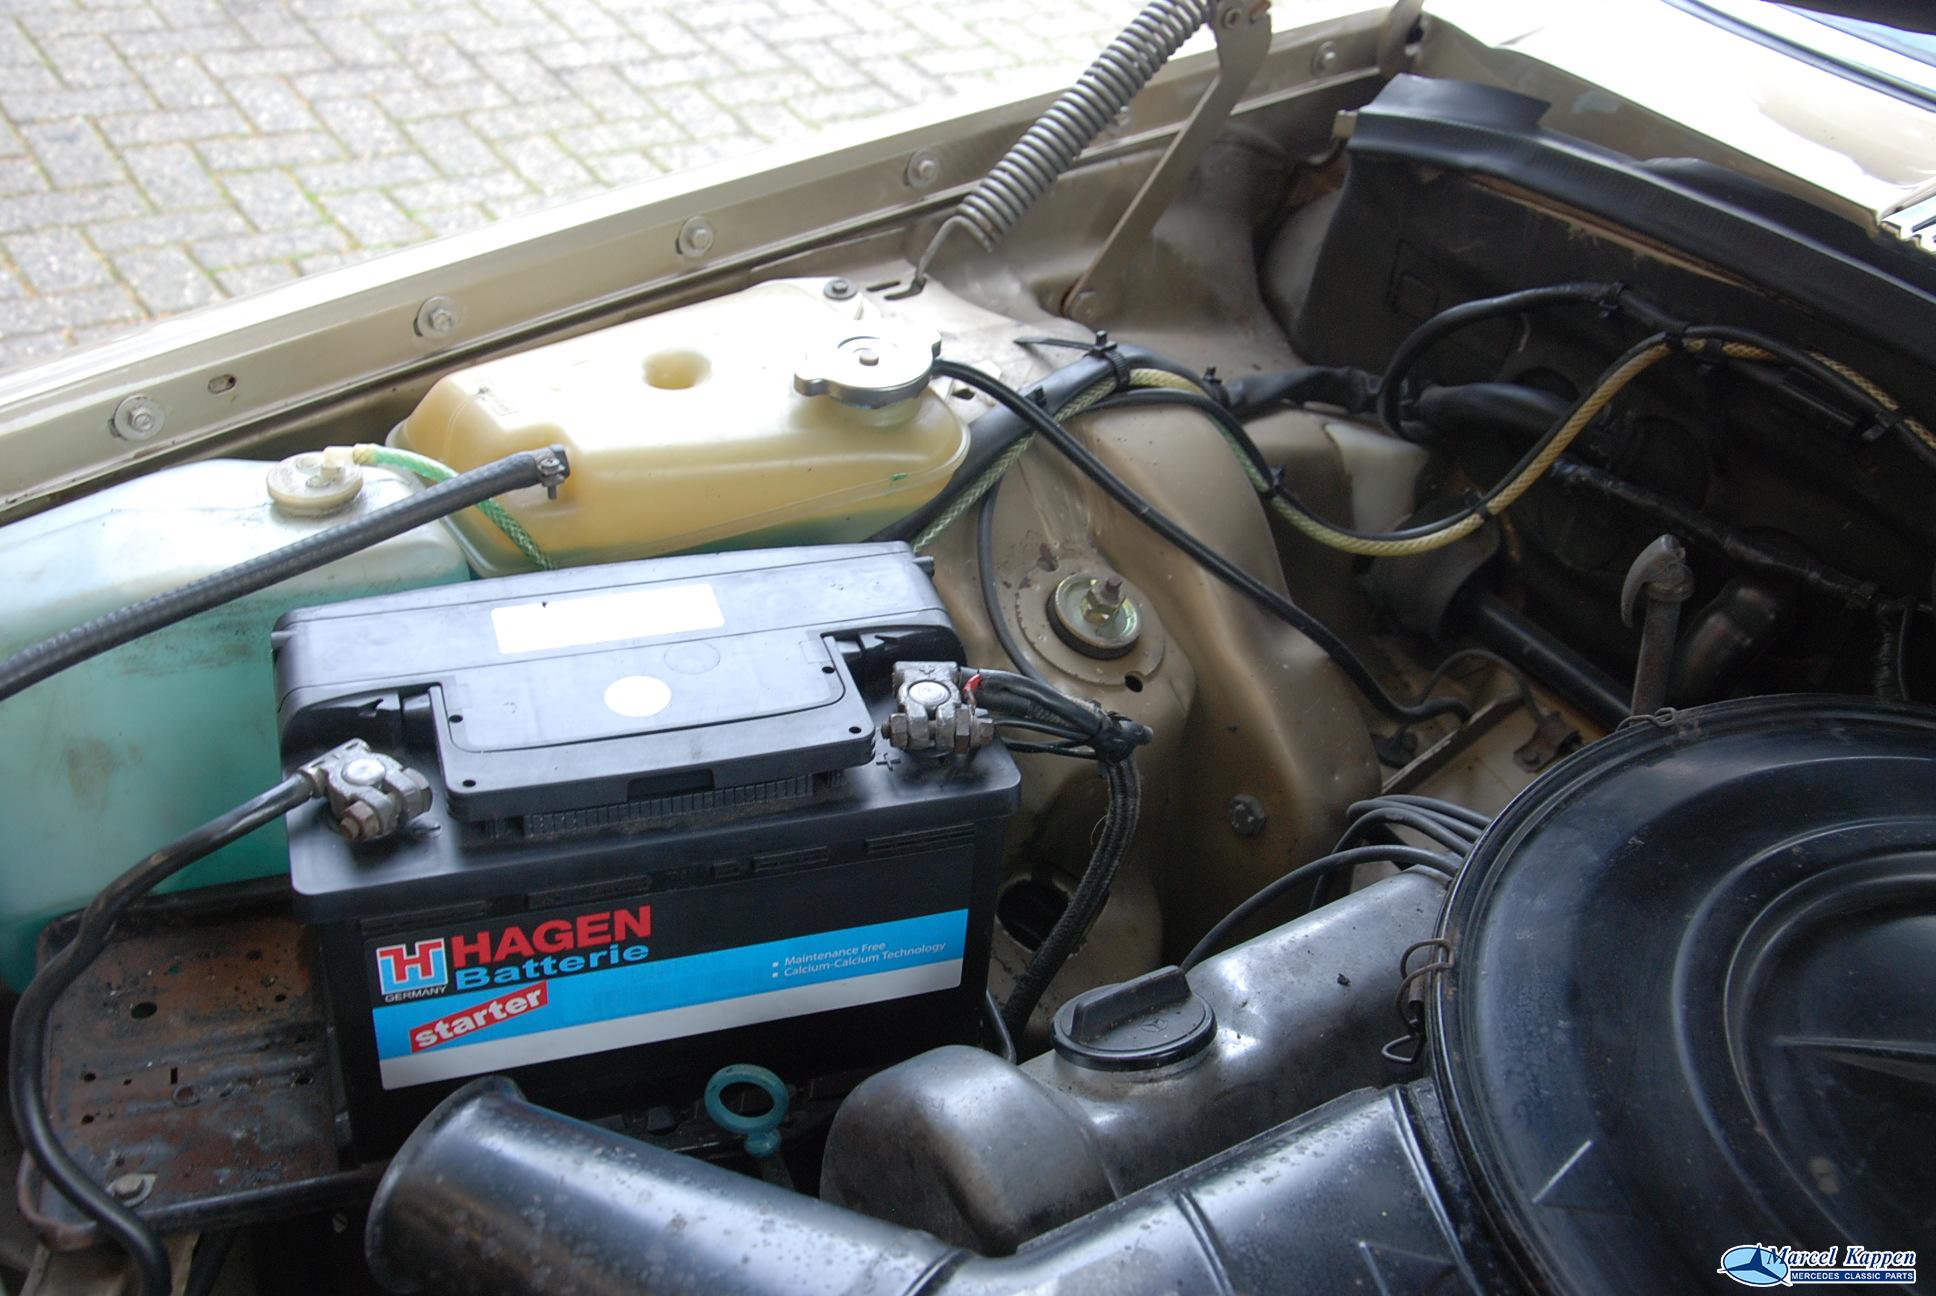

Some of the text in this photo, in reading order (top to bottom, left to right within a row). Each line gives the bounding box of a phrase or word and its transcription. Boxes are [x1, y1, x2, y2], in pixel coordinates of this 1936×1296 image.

[451, 904, 651, 968] HAGEN
[784, 941, 886, 966] Maintenance Free
[456, 943, 650, 990] Batterie
[784, 942, 947, 977] Calcium-Calcium Technology
[384, 985, 448, 1003] GERMANY
[414, 987, 543, 1049] starter
